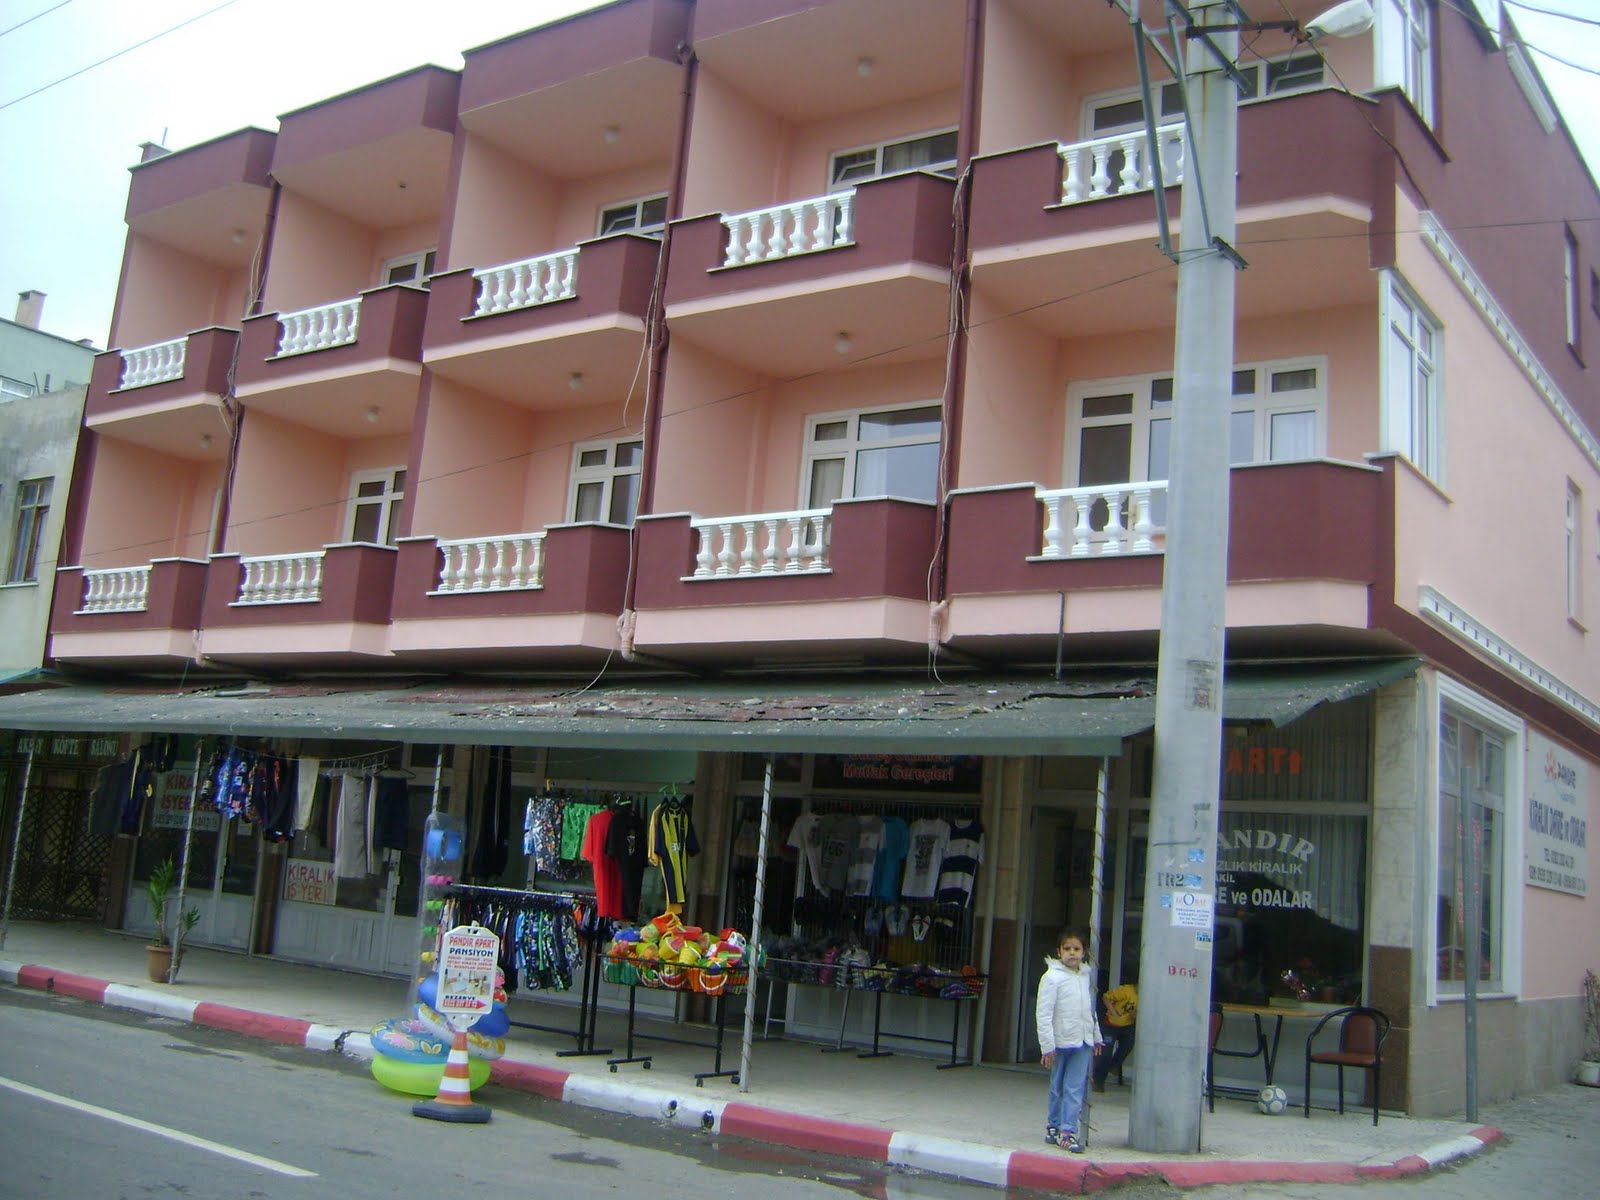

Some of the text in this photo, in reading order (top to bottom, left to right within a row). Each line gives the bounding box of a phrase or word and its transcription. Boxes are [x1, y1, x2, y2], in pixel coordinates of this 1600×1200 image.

[1249, 860, 1303, 875] KİRALIK
[1231, 891, 1247, 905] ve
[1252, 888, 1312, 909] ODALAR
[449, 947, 493, 957] PANSİYON
